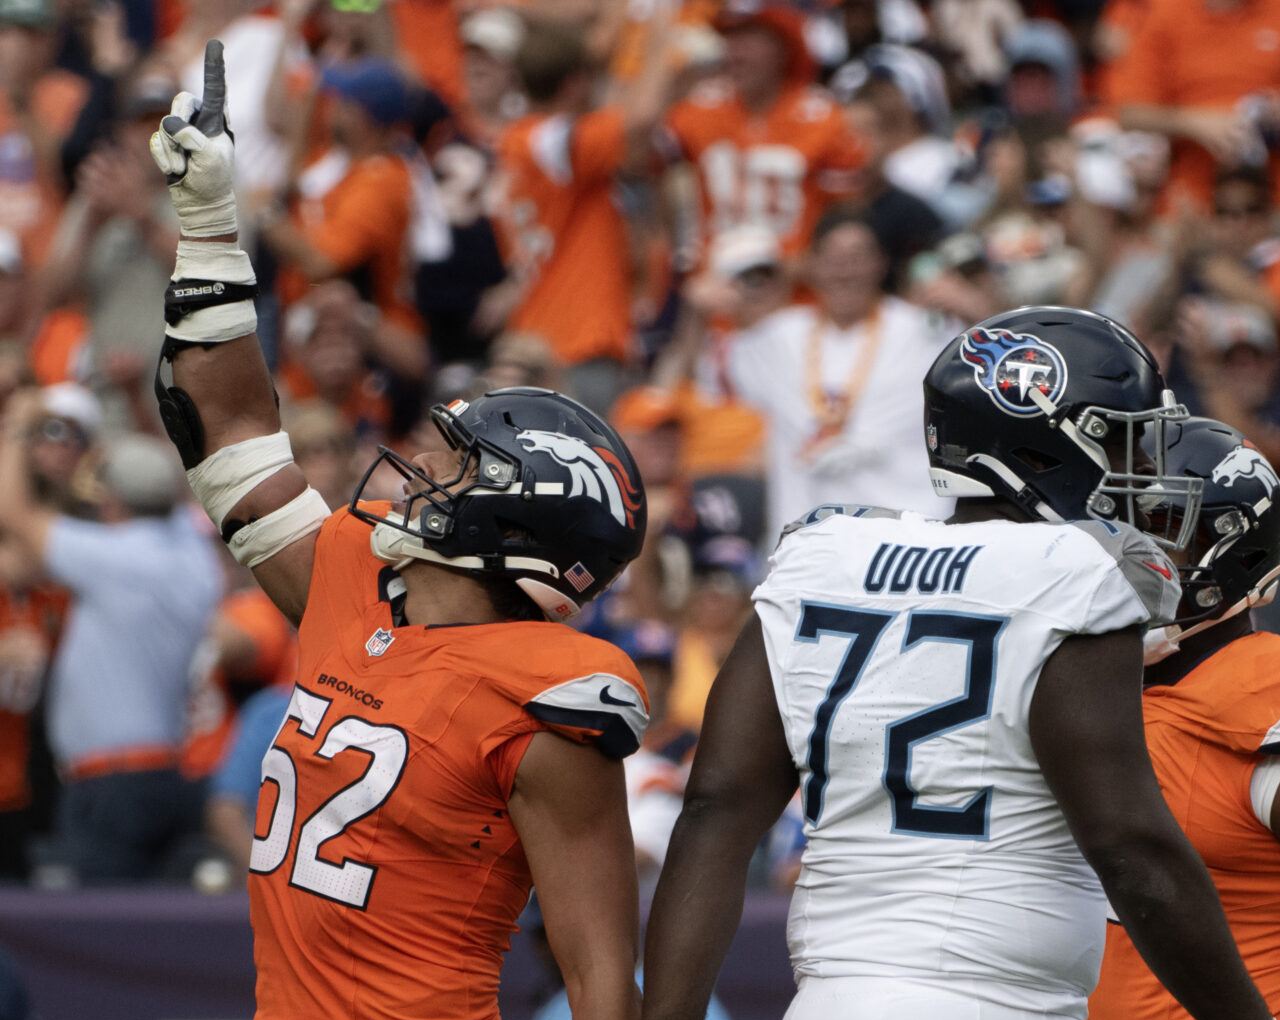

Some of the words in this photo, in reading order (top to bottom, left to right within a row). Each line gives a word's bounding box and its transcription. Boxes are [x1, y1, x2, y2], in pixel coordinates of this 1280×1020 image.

[862, 541, 986, 595] UDOH
[317, 673, 384, 710] BRONCOS
[793, 600, 1012, 841] 72
[248, 683, 409, 911] 52
